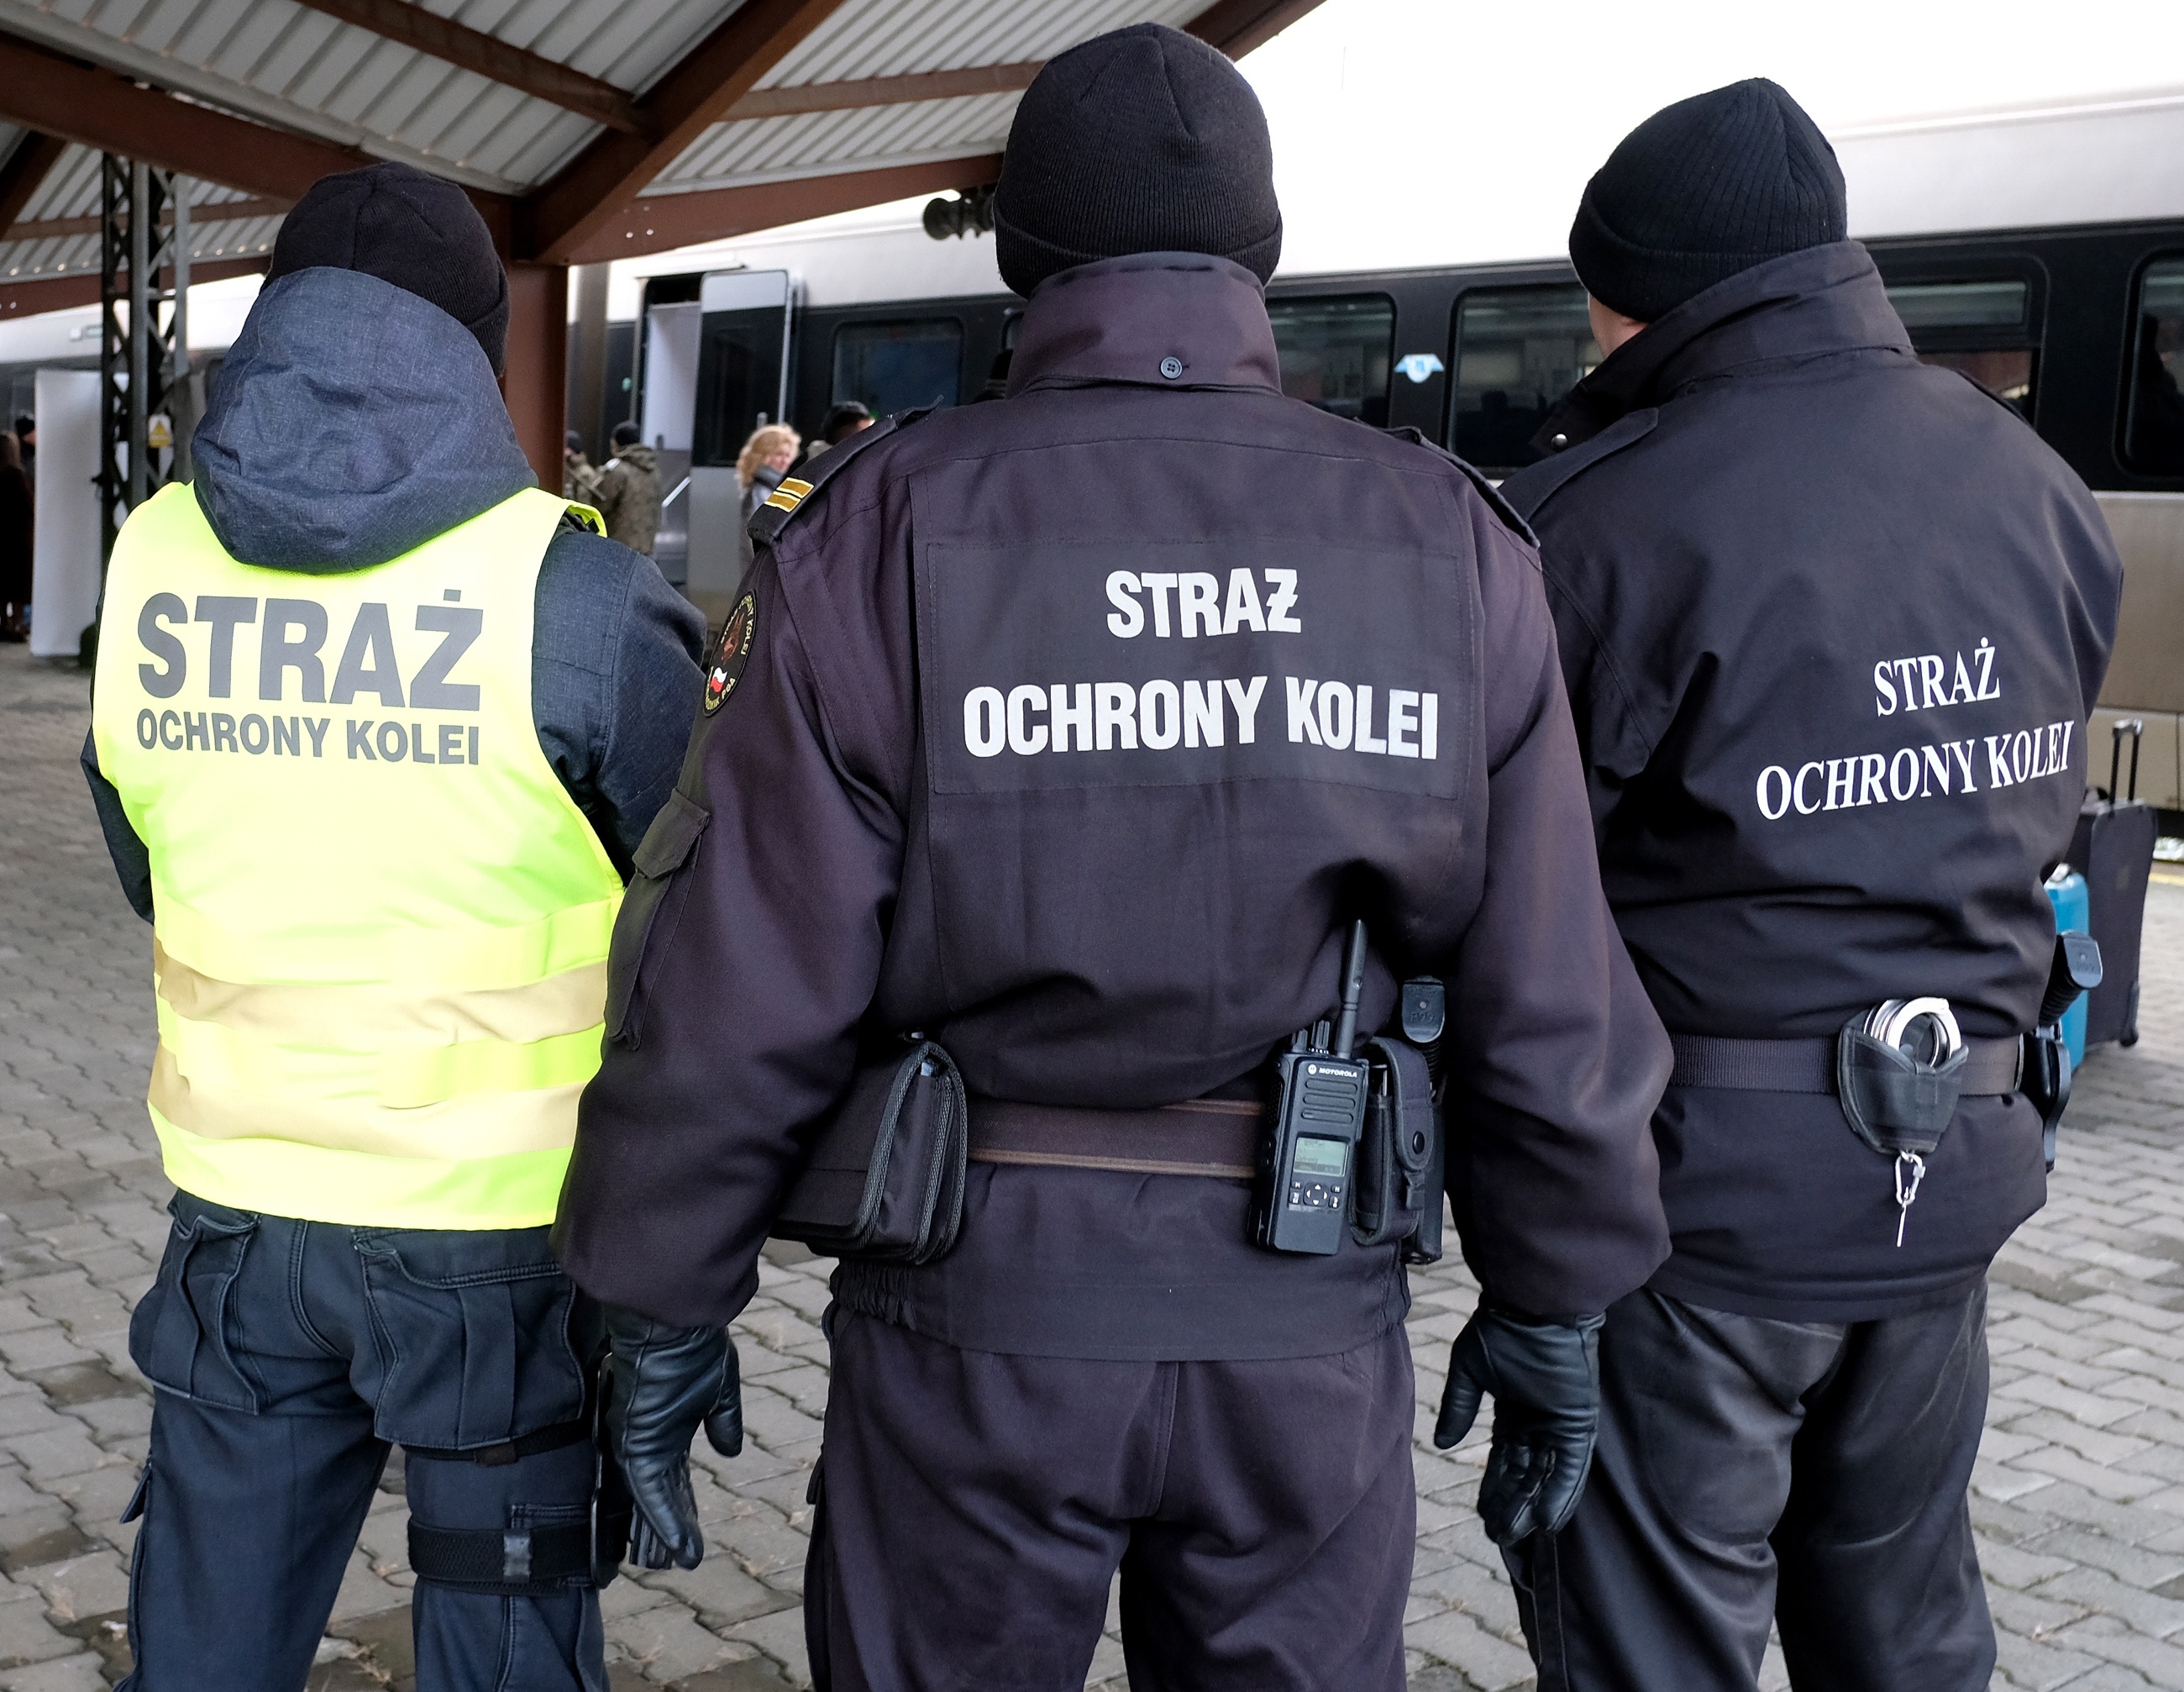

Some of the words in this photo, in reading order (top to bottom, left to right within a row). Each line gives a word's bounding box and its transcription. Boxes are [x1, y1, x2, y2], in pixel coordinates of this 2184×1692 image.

[137, 589, 484, 712] STRAŻ
[1873, 637, 2001, 717] STRAŻ
[136, 708, 331, 758] OCHRONY
[345, 719, 480, 765] KOLEI
[963, 675, 1268, 758] OCHRONY
[1285, 675, 1439, 760] KOLEI
[1756, 738, 1978, 820] OCHRONY
[1982, 720, 2076, 790] KOLEI
[1319, 1067, 1357, 1078] MOTOROLA
